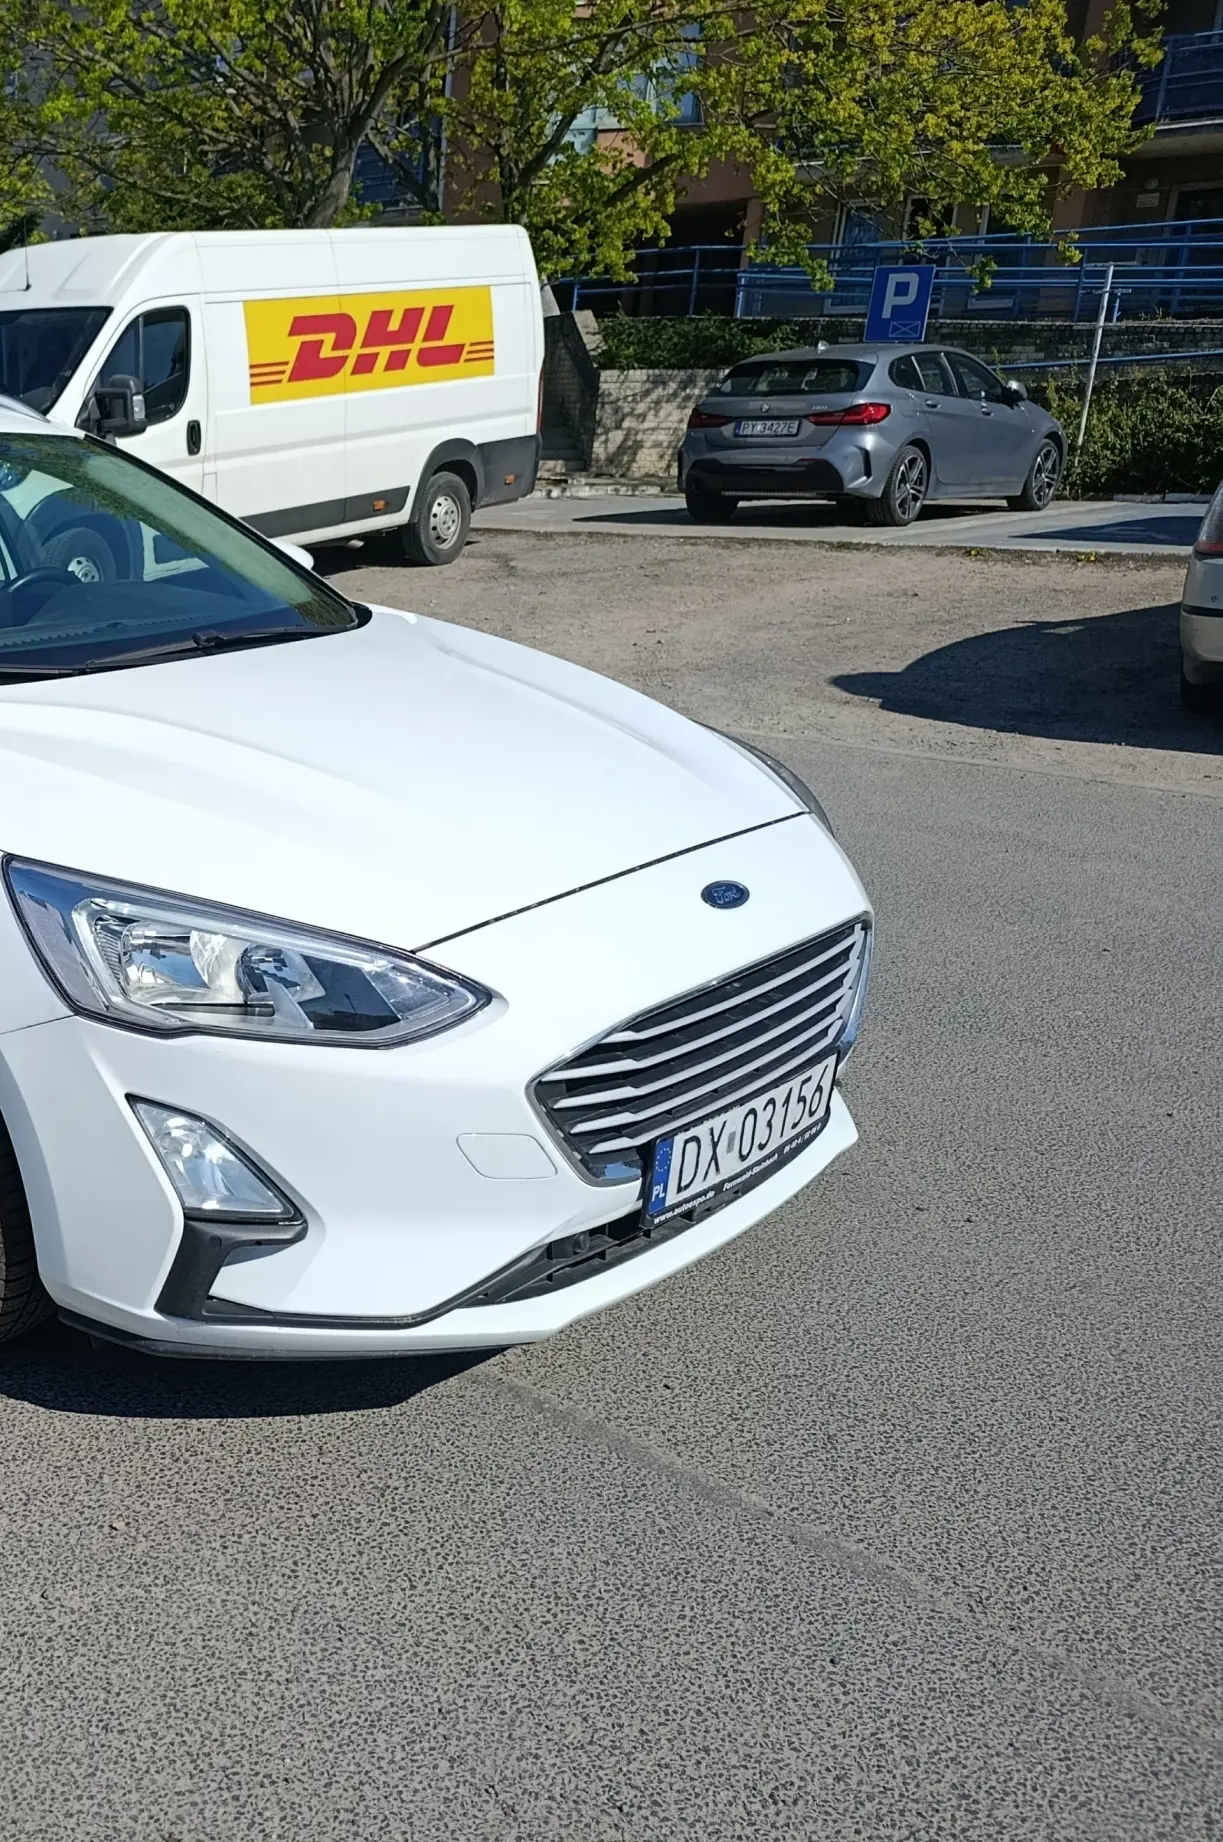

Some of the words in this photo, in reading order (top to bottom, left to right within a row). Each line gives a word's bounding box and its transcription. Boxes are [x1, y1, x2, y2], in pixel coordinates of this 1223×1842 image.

[881, 273, 920, 319] P
[288, 305, 465, 381] DHL
[742, 422, 757, 434] PY
[759, 421, 796, 434] 3427E
[712, 886, 740, 904] Ford
[676, 1120, 728, 1195] DX
[738, 1063, 829, 1163] 03156
[651, 1183, 666, 1202] PL
